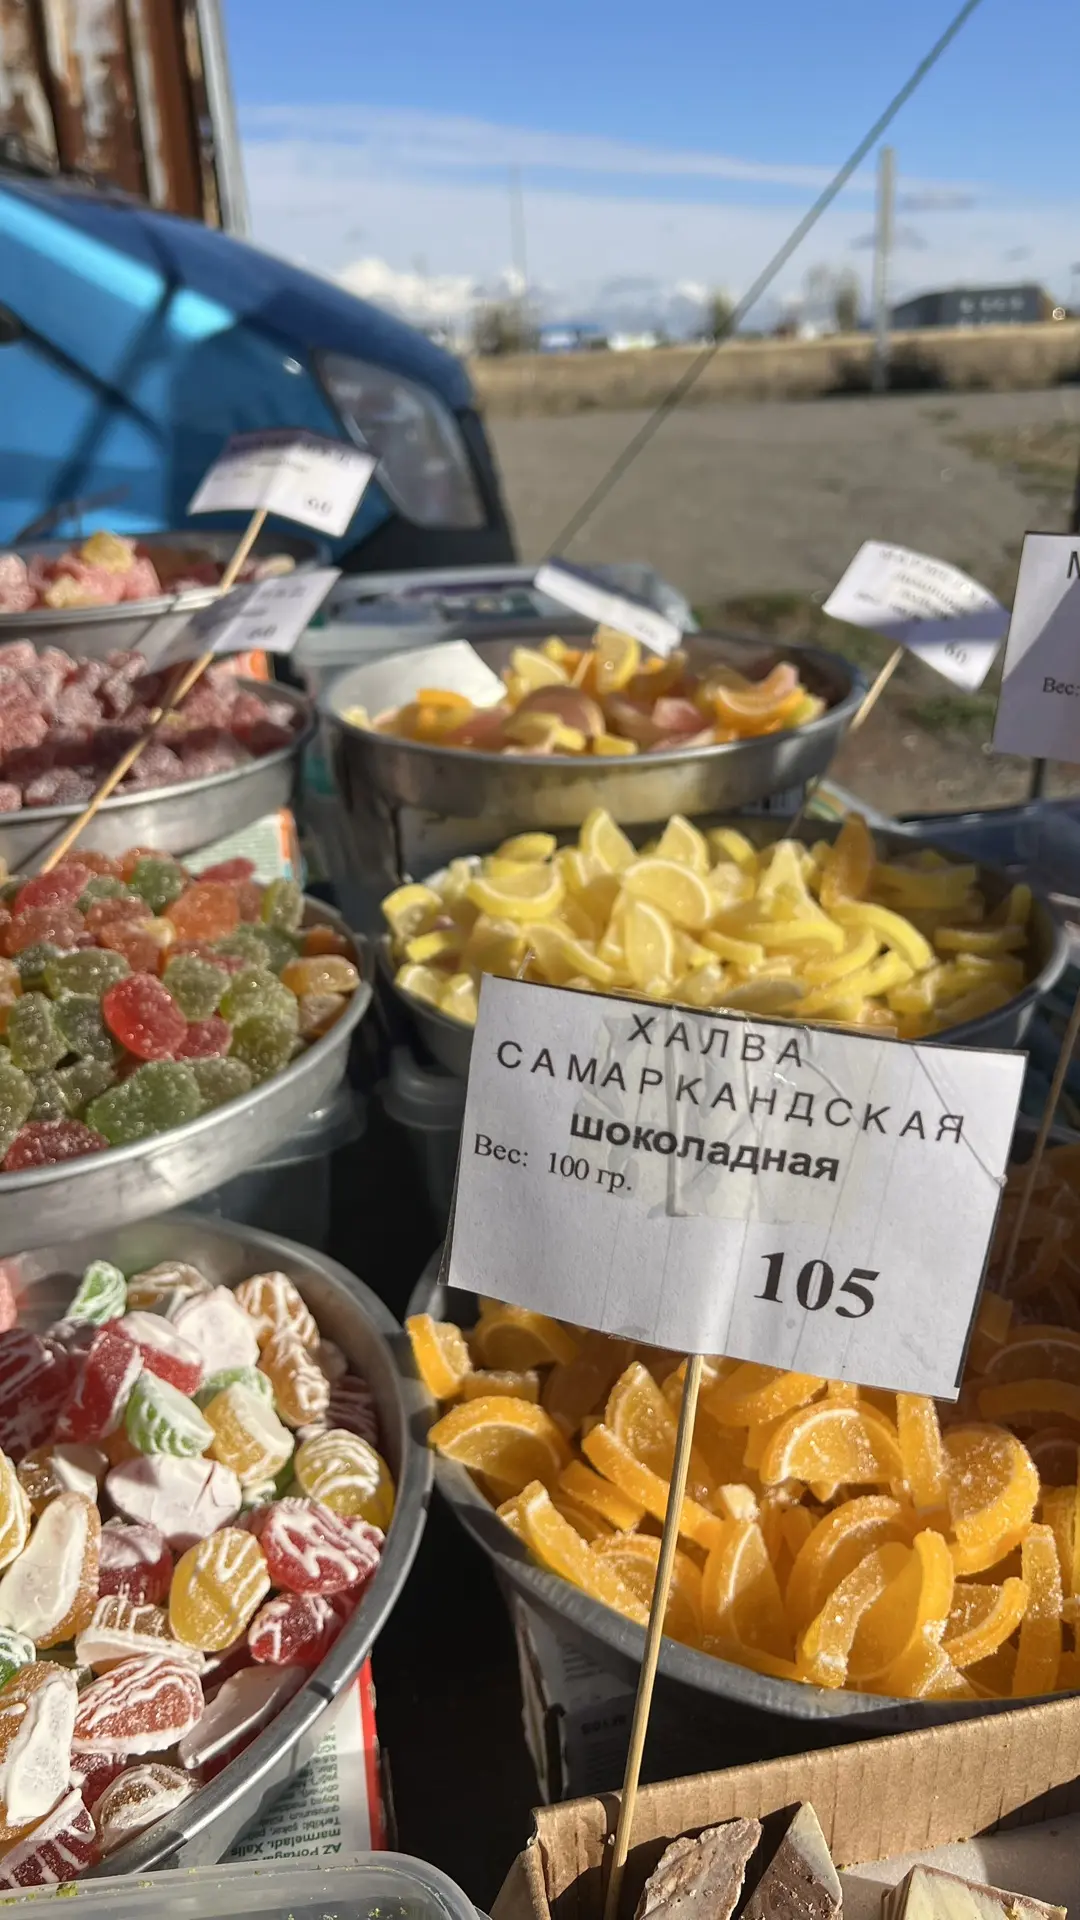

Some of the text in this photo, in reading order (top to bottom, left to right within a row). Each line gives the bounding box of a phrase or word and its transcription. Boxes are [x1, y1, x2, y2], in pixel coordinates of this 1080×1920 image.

[627, 1013, 803, 1068] ХАЛВА
[497, 1040, 965, 1144] САМАРКАНДСКАЯ
[473, 1133, 632, 1194] Вес: 100 гр.
[569, 1112, 840, 1182] шоколадная
[753, 1251, 881, 1319] 105
